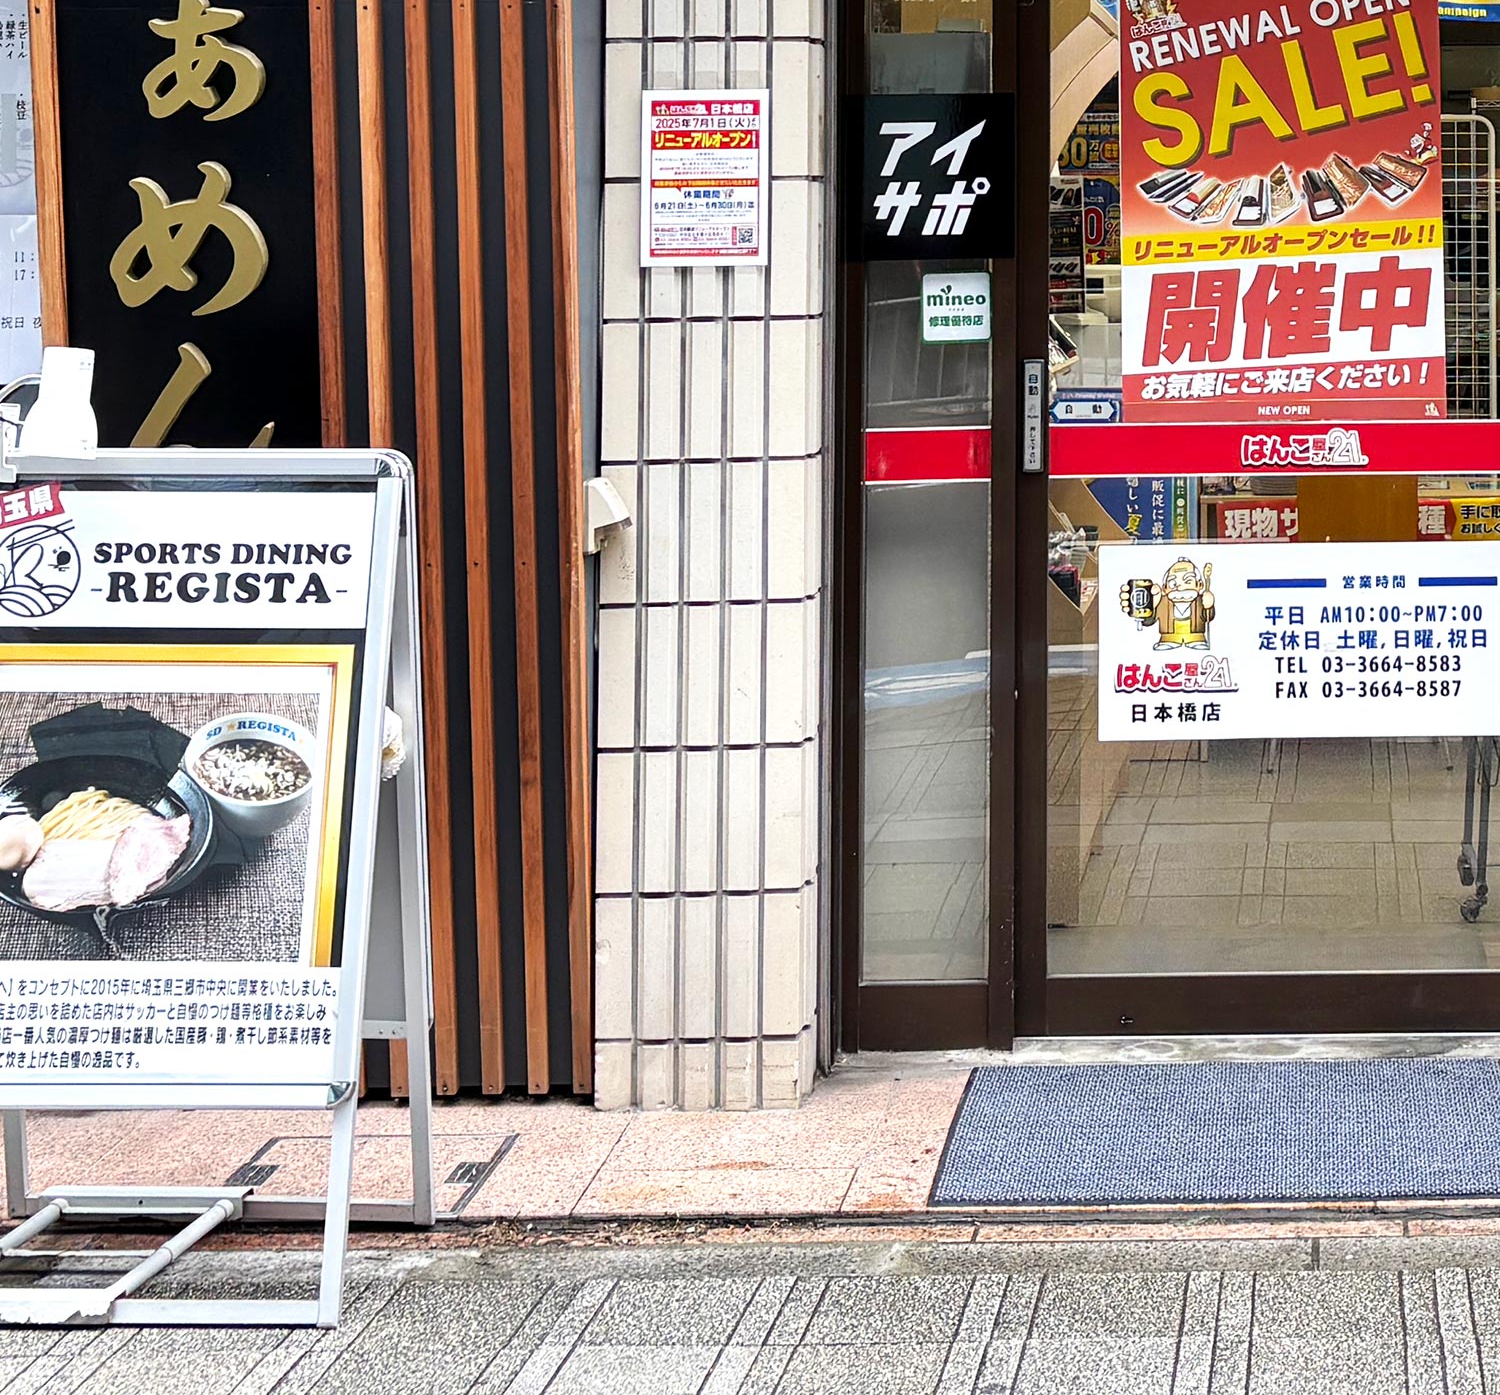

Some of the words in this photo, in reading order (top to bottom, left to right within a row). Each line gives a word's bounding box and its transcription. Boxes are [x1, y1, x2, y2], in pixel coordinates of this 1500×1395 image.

[1438, 6, 1488, 18] ampaign
[1128, 3, 1301, 72] RENEWAL
[1132, 11, 1435, 169] SALE!
[879, 119, 987, 177] アイ
[873, 177, 991, 236] サポ
[926, 285, 987, 307] mineo
[1142, 254, 1433, 367] 開催中
[1141, 361, 1429, 401] お気軽にご来店ください!
[1257, 405, 1280, 416] NEW
[1283, 405, 1311, 416] OPEN
[0, 484, 54, 525] 玉県
[93, 542, 221, 565] SPORTS
[231, 543, 353, 566] DINING
[1342, 575, 1407, 589] 営業時間
[1265, 606, 1304, 626] 平日
[1258, 630, 1320, 651] 定休日
[1275, 656, 1309, 673] TEL
[1322, 655, 1462, 673] 03-3664-8583
[1275, 681, 1309, 699] FAX
[1322, 680, 1462, 698] 03-3664-8587
[1131, 702, 1222, 723] 日本橋店
